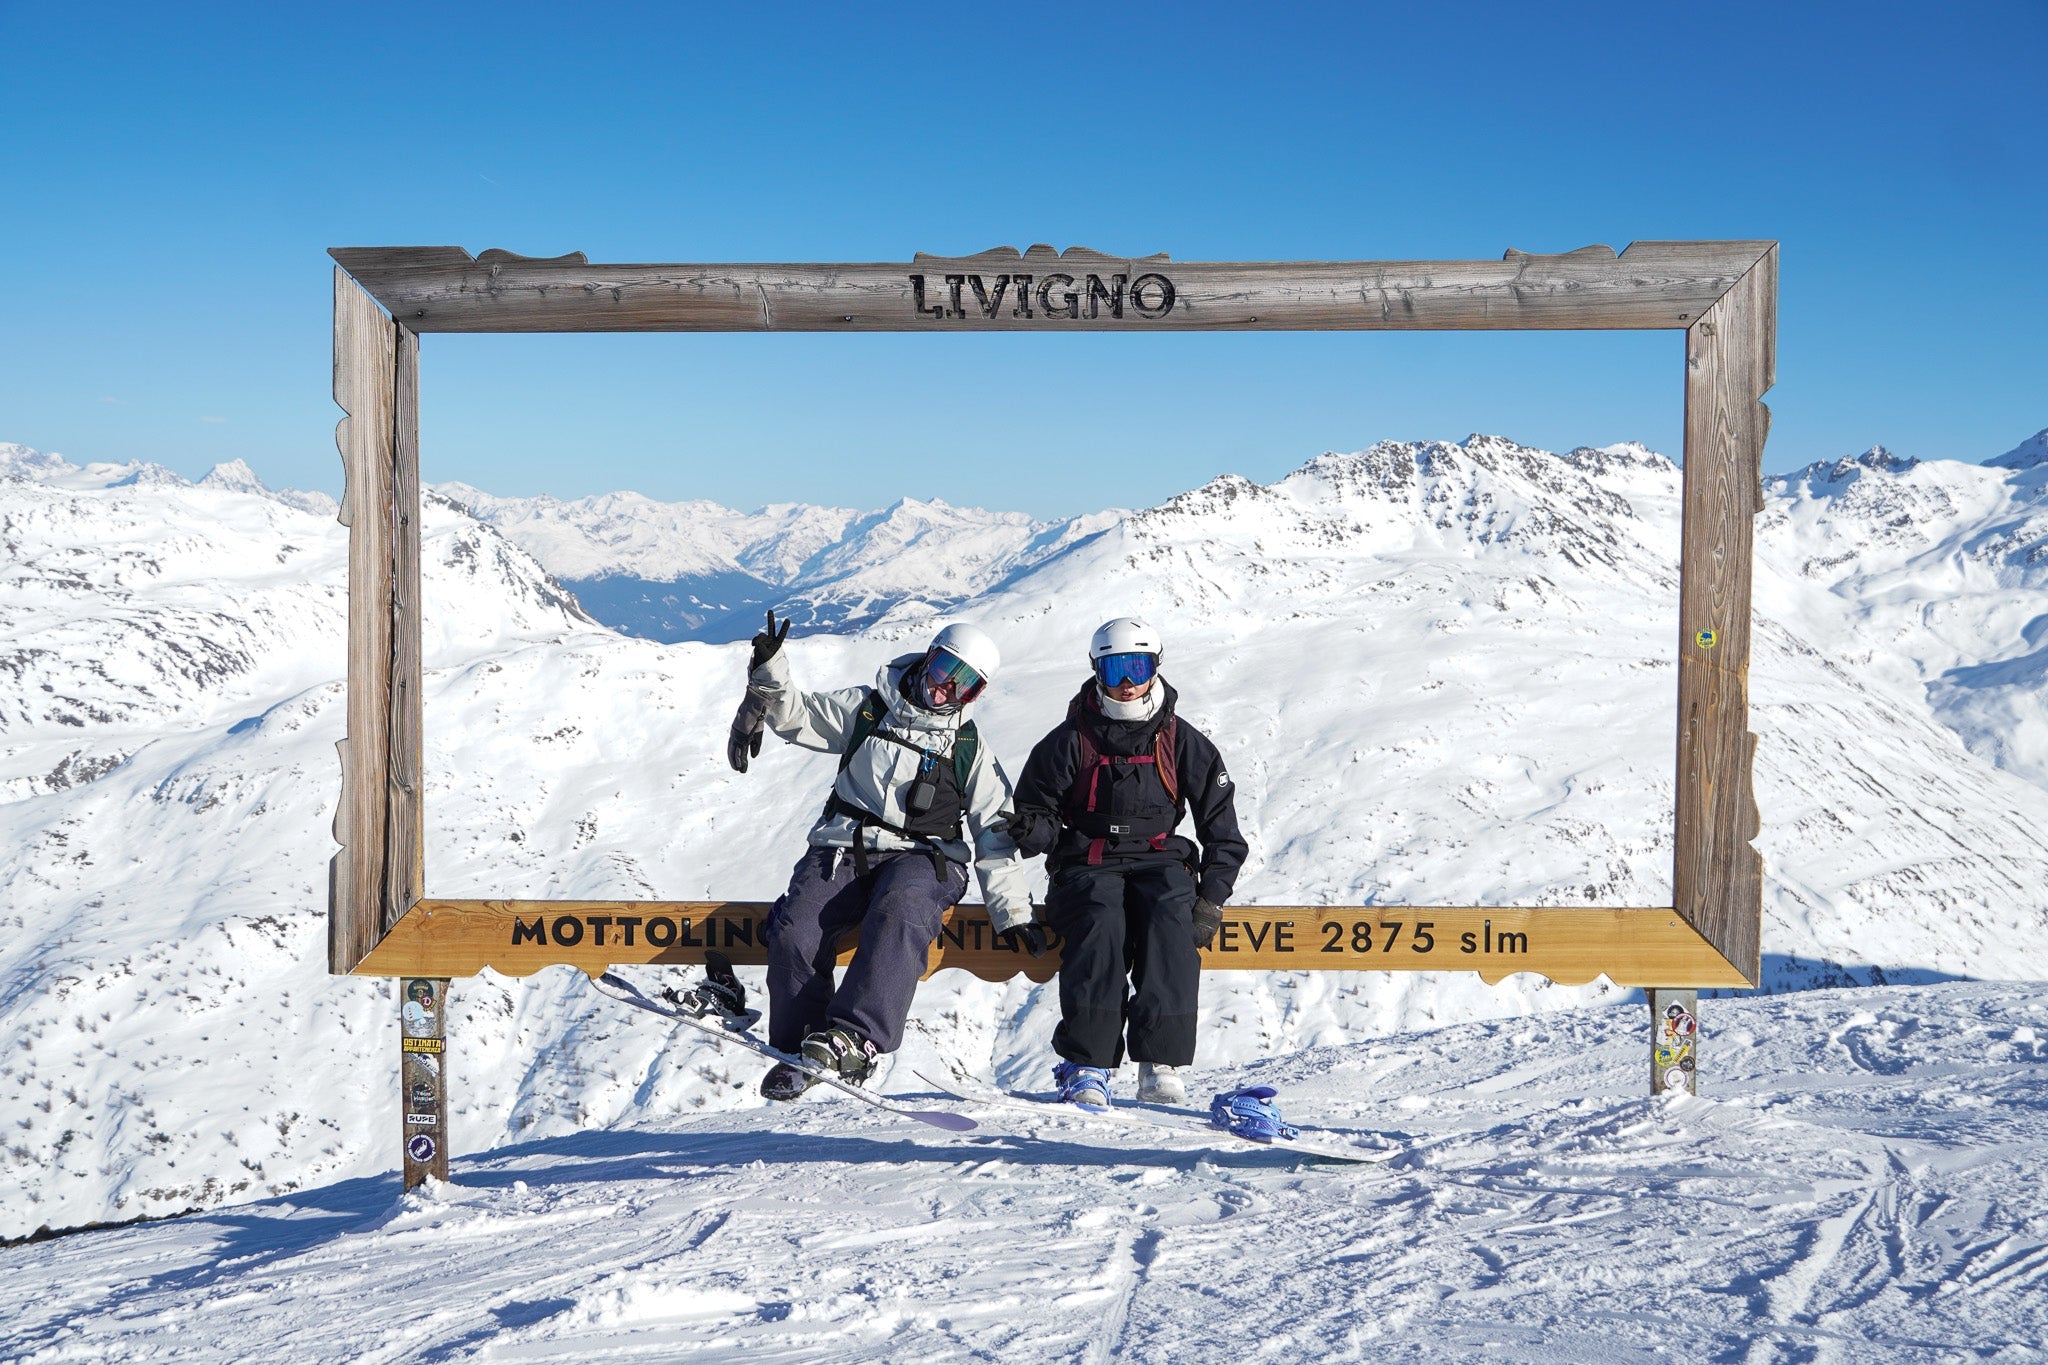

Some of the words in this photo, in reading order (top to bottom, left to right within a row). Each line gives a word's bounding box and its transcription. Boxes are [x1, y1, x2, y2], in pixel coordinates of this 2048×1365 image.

[908, 272, 1176, 320] LIVIGNO
[1204, 921, 1295, 952] EVE
[1320, 921, 1435, 953] 2875
[1460, 919, 1528, 953] slm
[409, 1115, 434, 1123] RUPE
